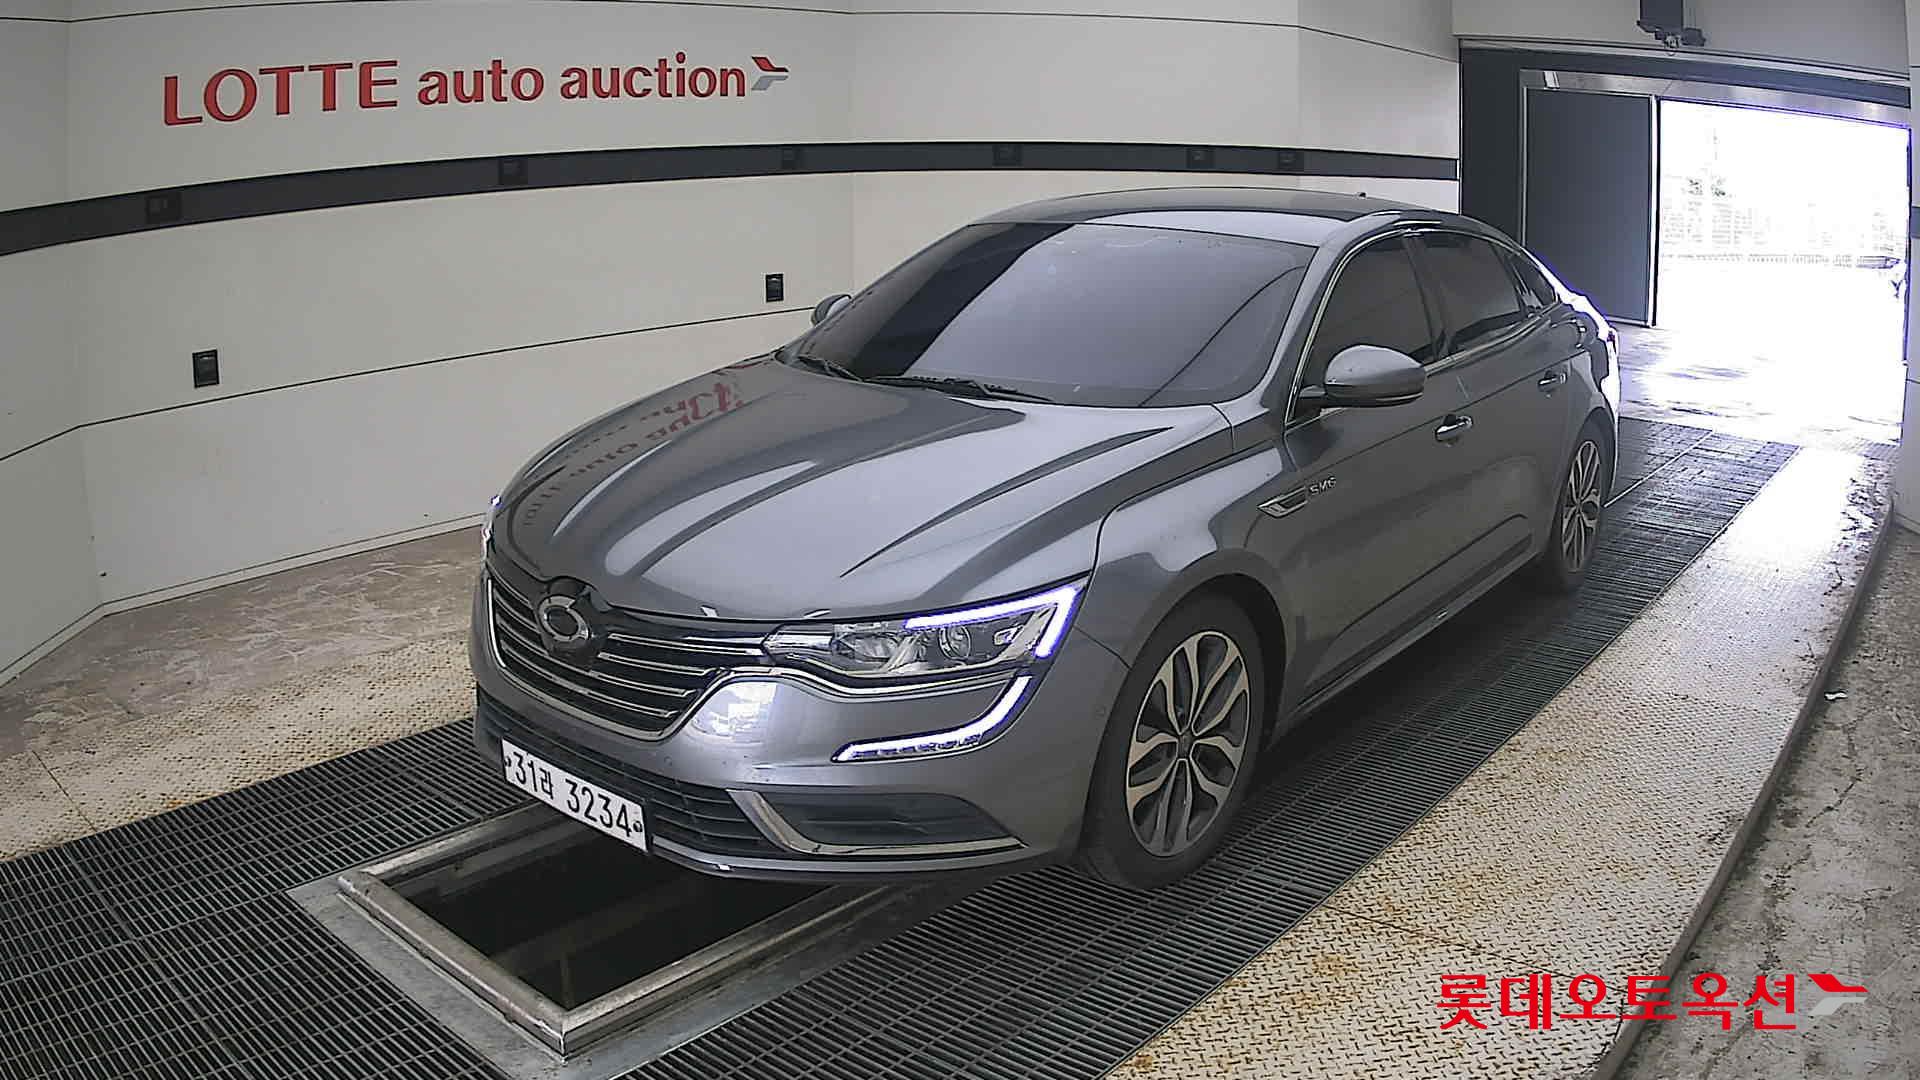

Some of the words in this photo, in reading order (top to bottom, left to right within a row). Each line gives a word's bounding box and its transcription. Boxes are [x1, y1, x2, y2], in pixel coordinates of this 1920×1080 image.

[164, 60, 398, 126] LOTTE
[418, 59, 544, 105] auto
[560, 51, 747, 98] auction
[513, 751, 554, 800] 31라
[565, 778, 632, 837] 3234
